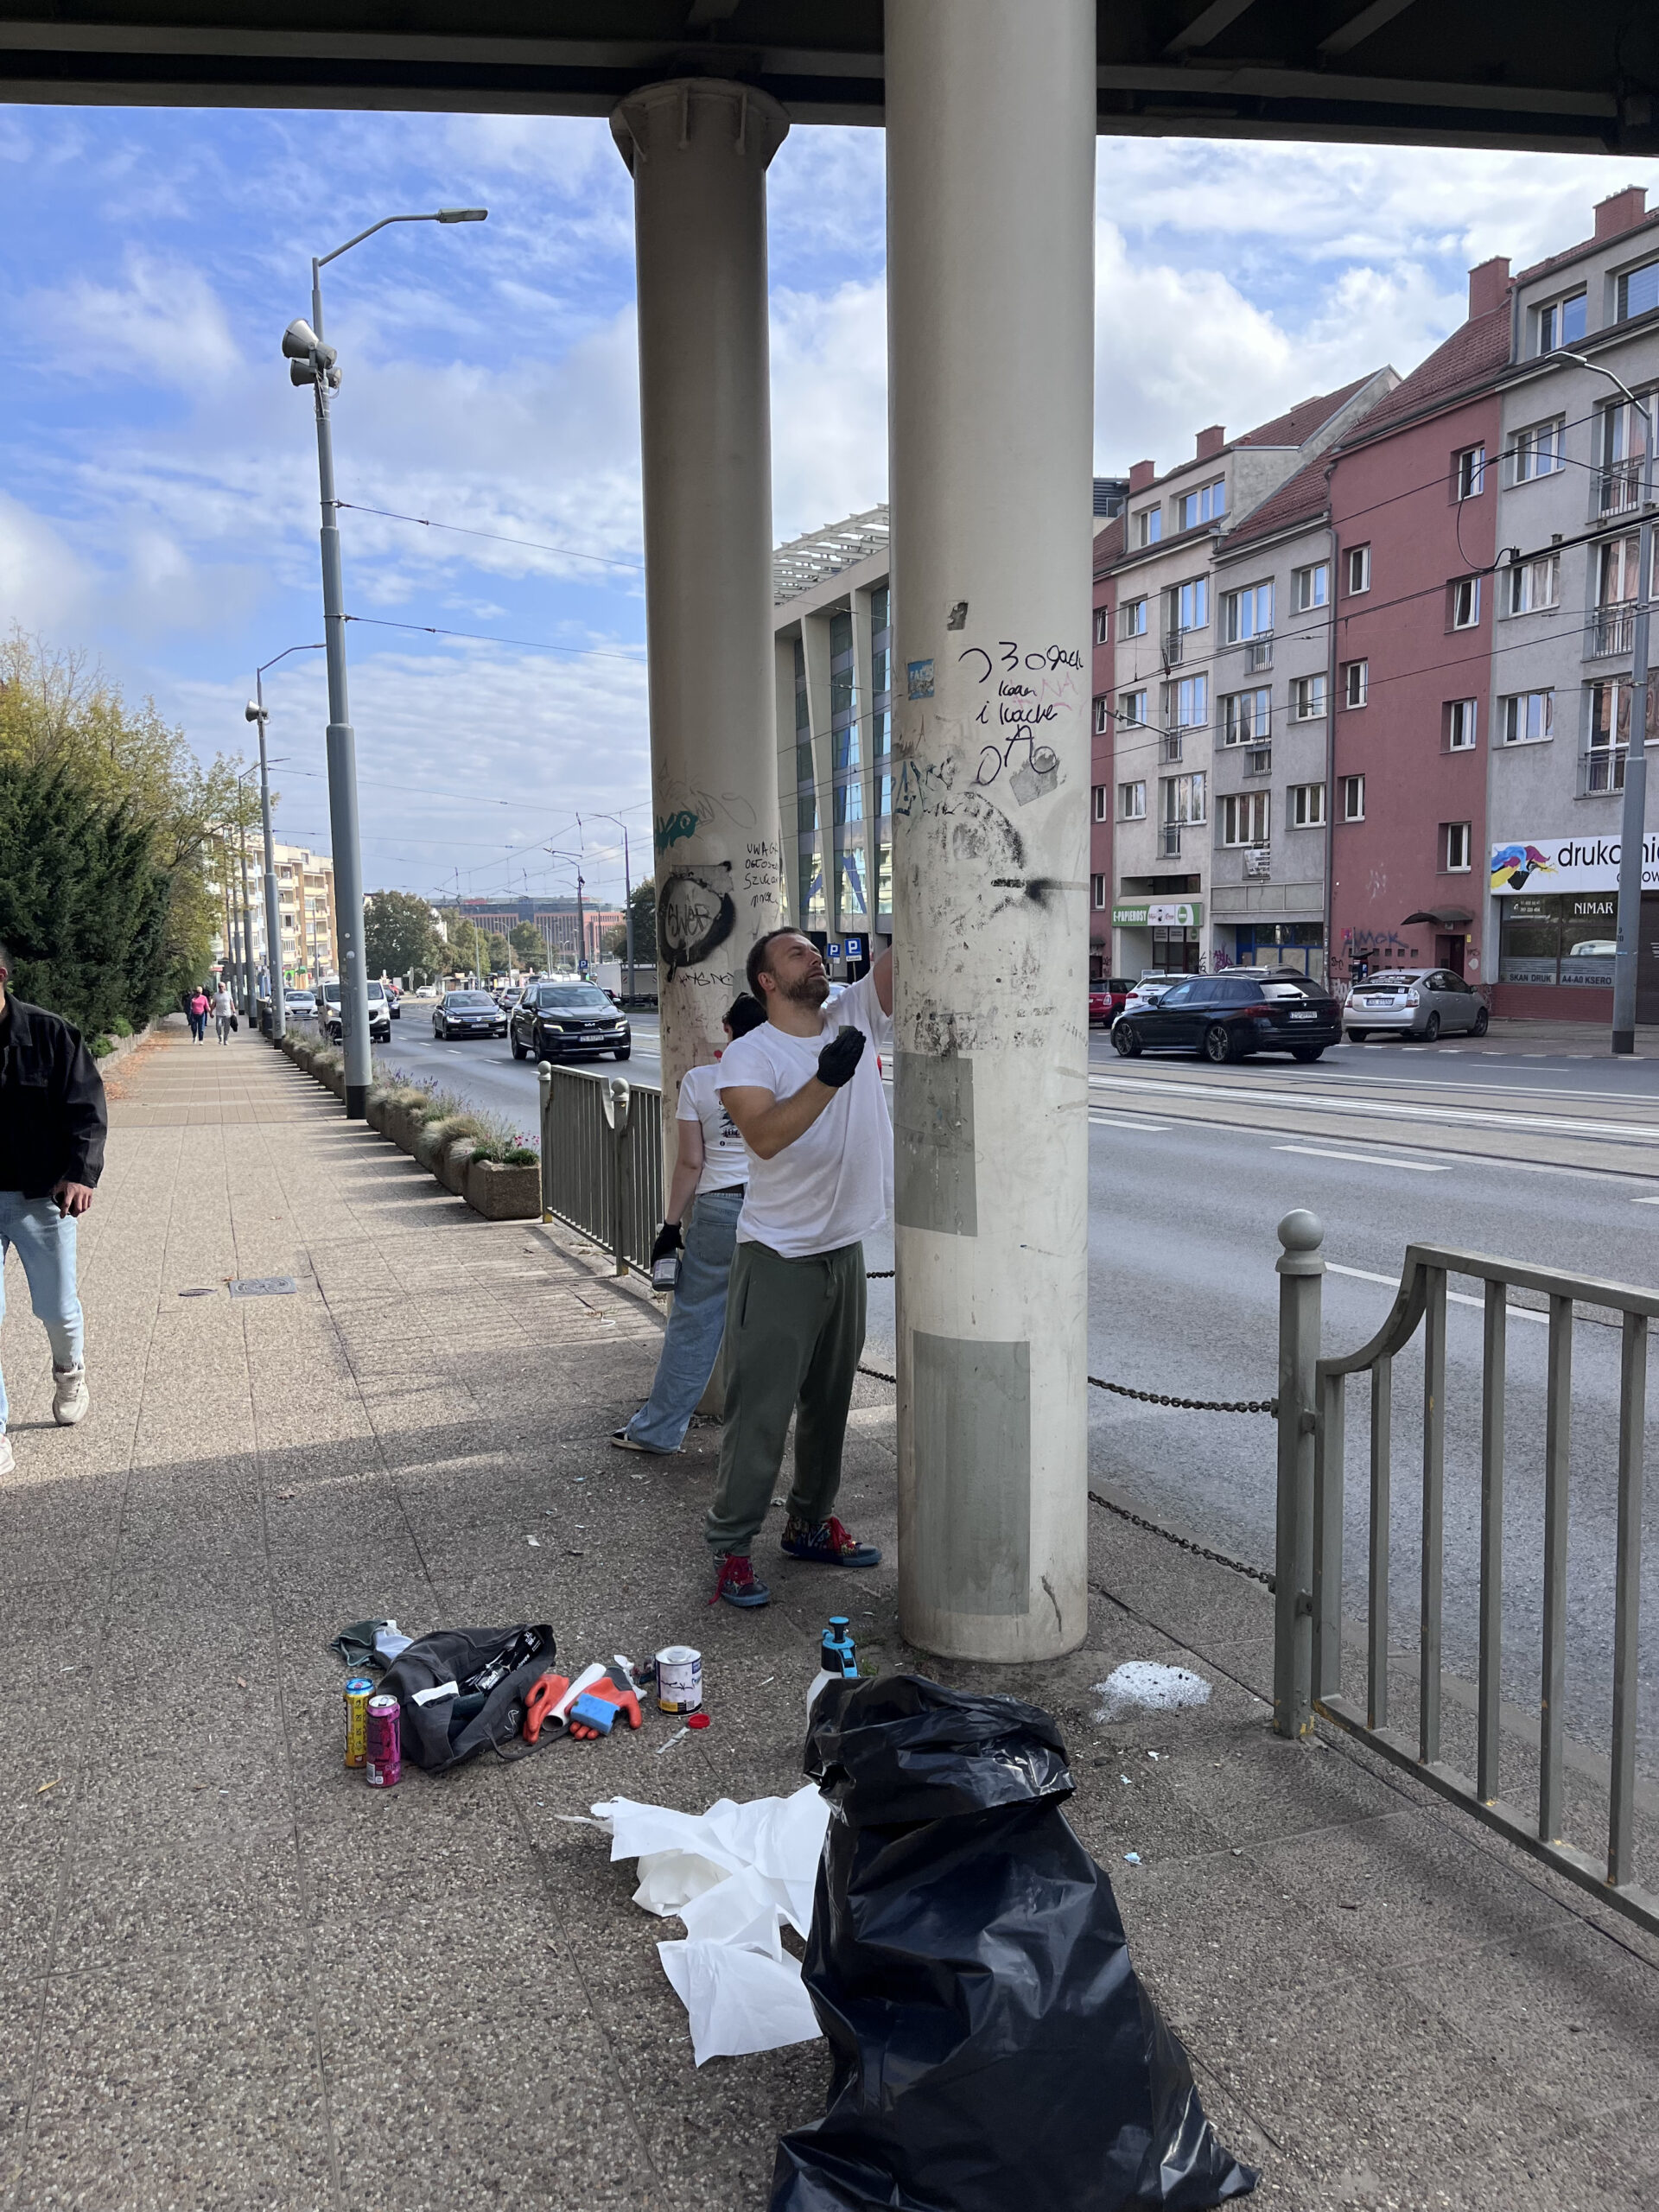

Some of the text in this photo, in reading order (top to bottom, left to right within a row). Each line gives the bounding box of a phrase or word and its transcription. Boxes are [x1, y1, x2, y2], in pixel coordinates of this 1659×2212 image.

[1573, 901, 1614, 915] NIMAR
[1113, 910, 1147, 923] E-PAPIEROSY
[1510, 974, 1552, 983] SKAN DRUK
[1585, 976, 1612, 985] KSERO
